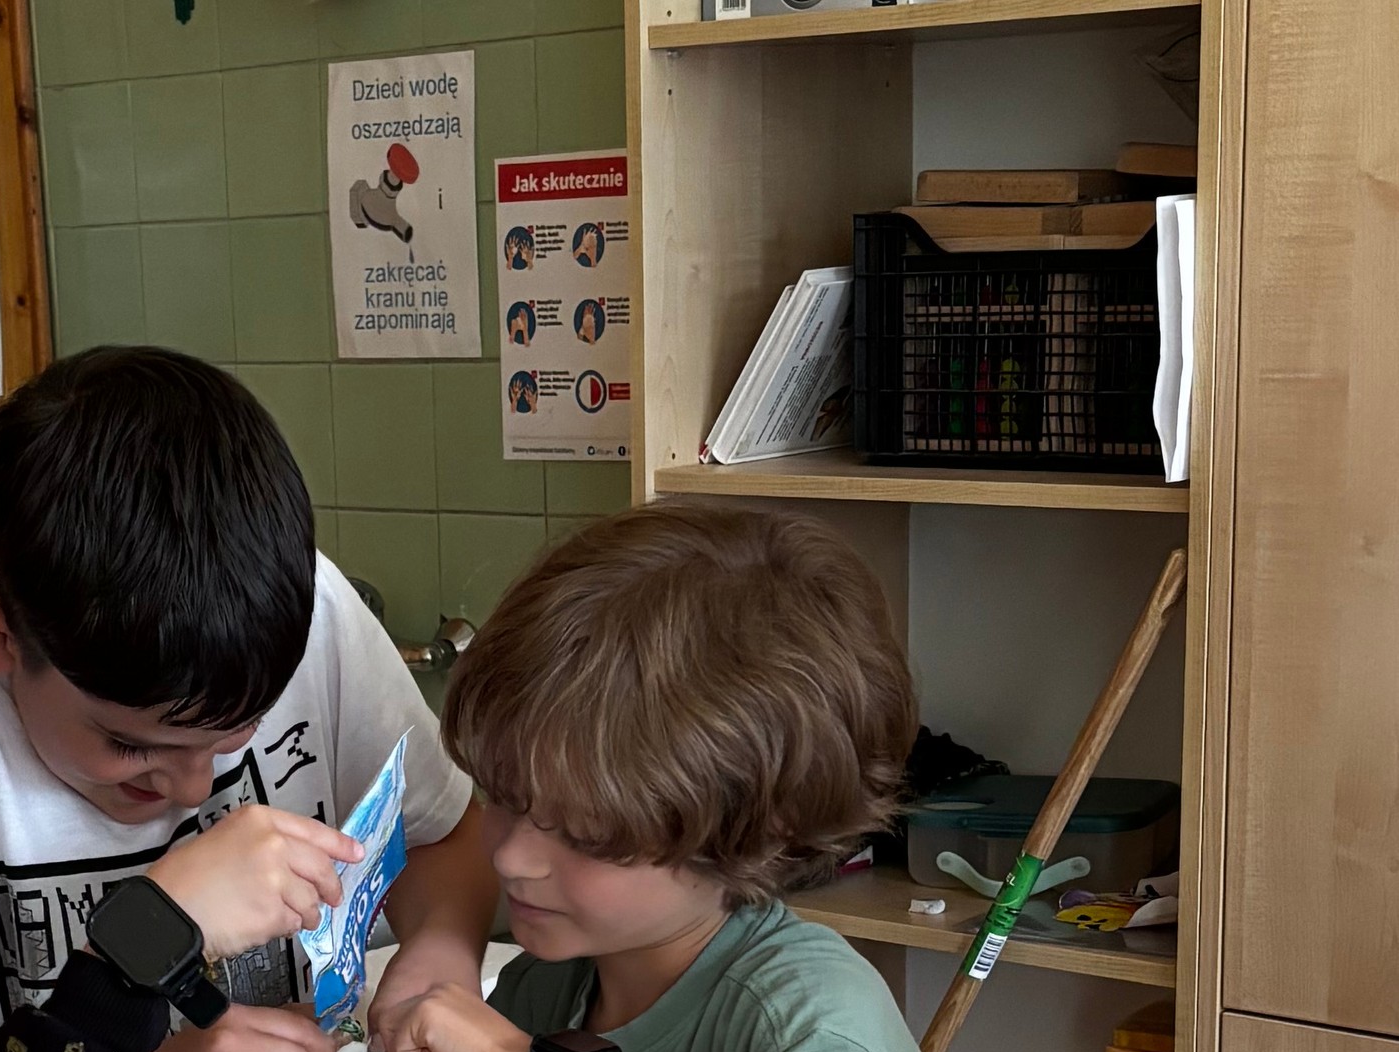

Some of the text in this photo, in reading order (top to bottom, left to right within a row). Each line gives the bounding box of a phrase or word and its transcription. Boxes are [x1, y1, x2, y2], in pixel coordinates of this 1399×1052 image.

[353, 72, 458, 102] Dzieci wodę
[352, 114, 462, 142] oszczędzają
[511, 167, 624, 194] Jak skutecznie
[438, 188, 443, 211] i
[364, 260, 447, 290] zakręcać
[365, 286, 449, 310] kranu nie
[354, 309, 457, 334] zapominają
